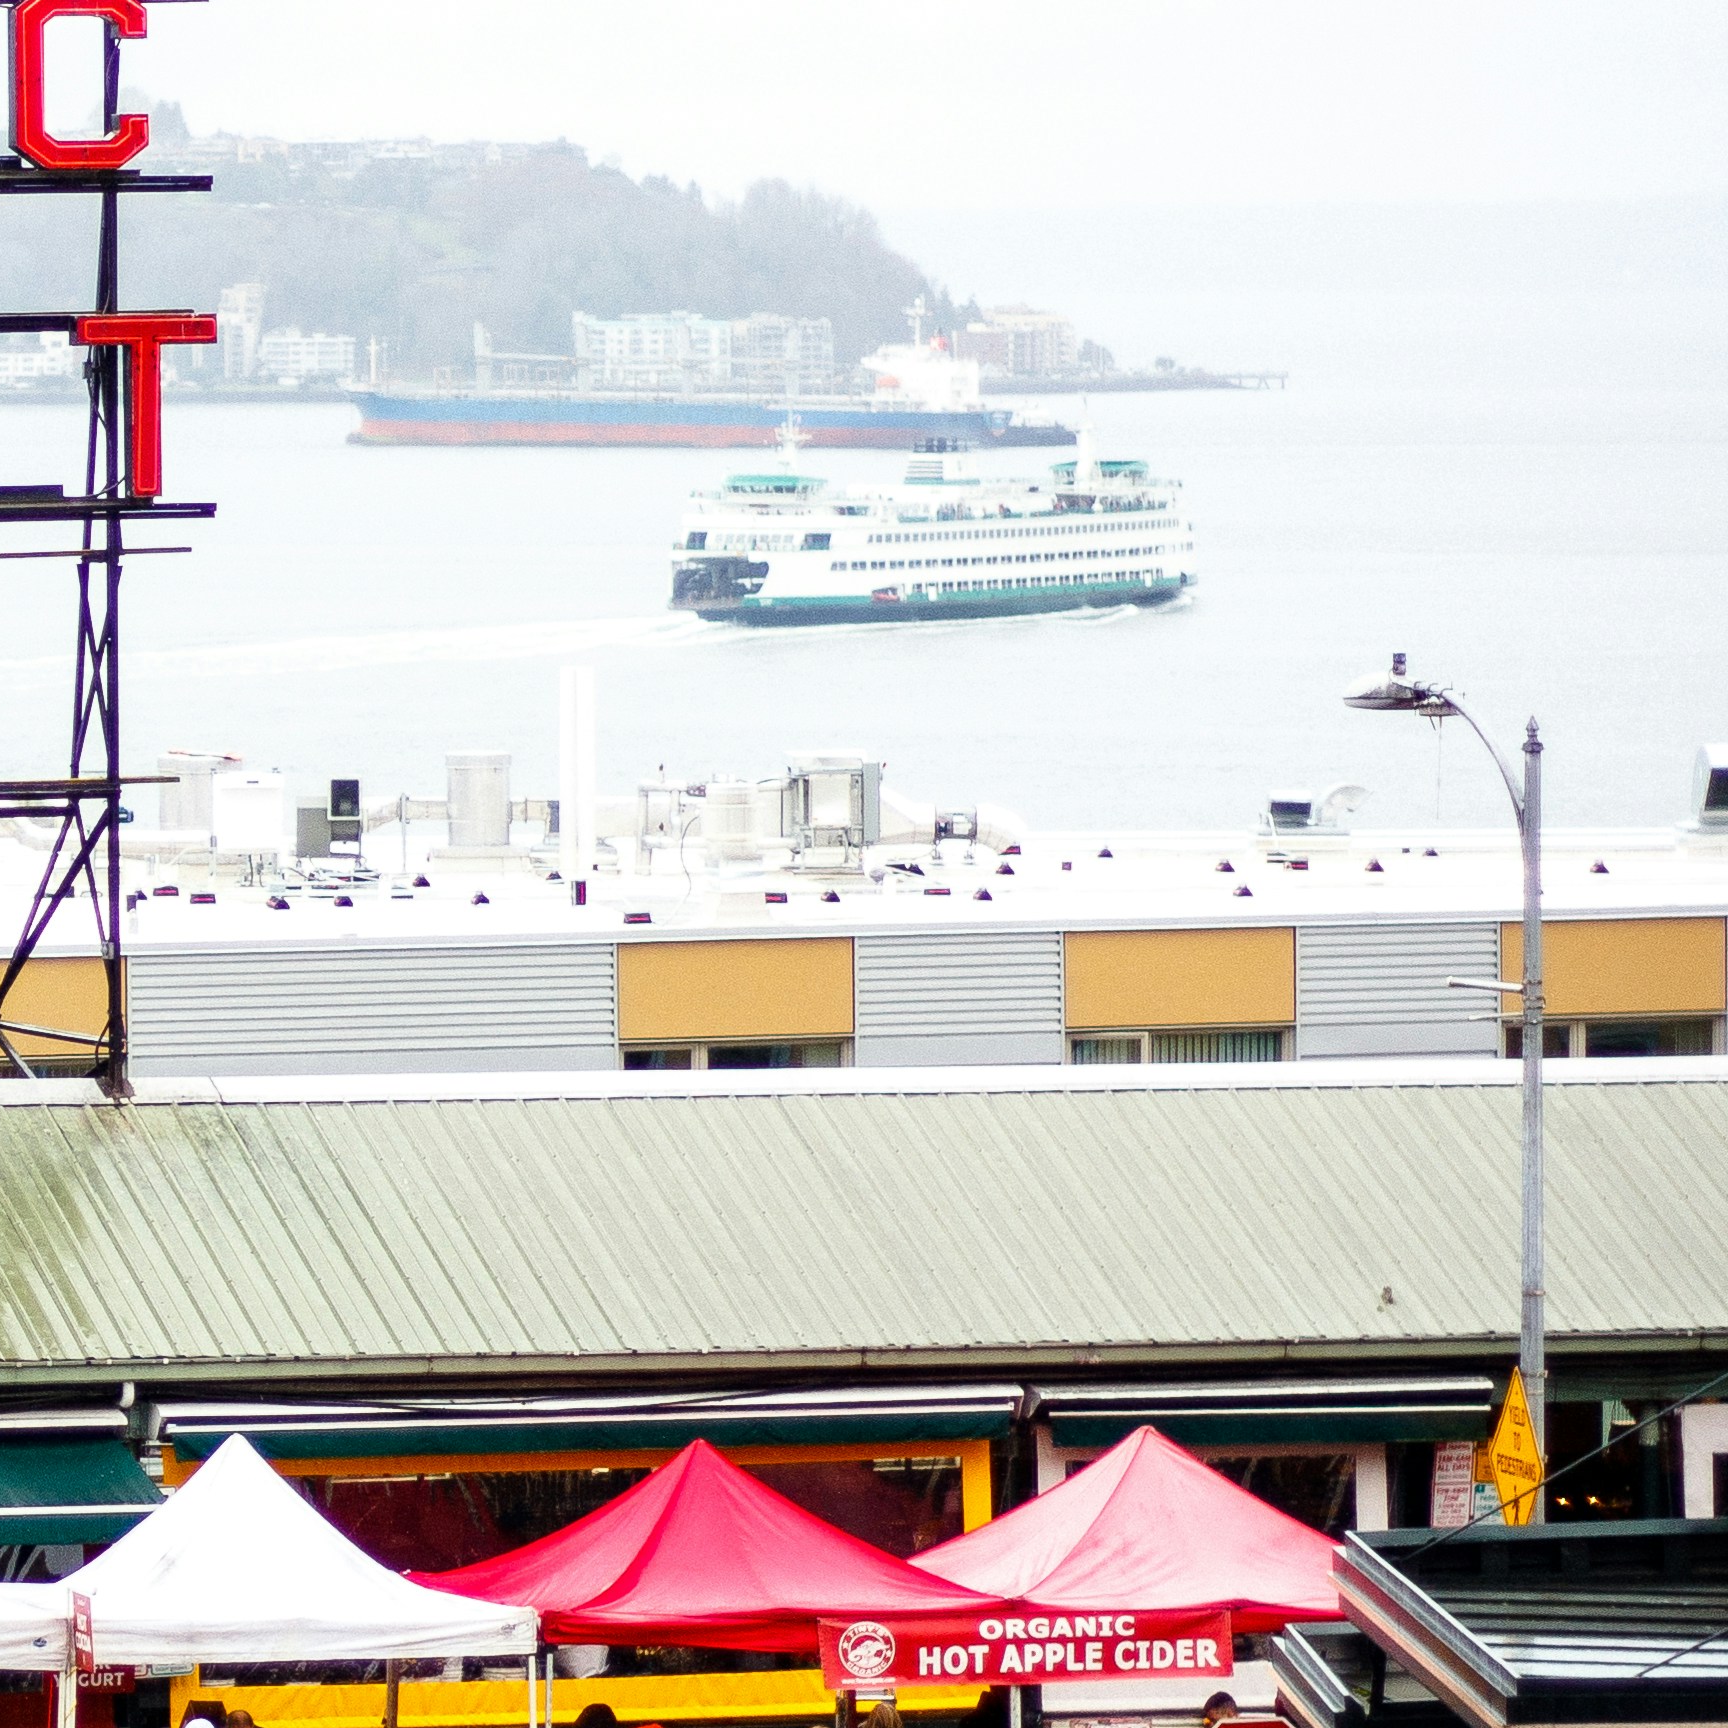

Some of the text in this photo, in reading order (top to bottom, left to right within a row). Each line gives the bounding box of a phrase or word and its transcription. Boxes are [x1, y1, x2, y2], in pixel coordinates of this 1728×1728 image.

[978, 1615, 1136, 1640] ORGANIC
[918, 1639, 1222, 1677] HOT APPLE CIDER
